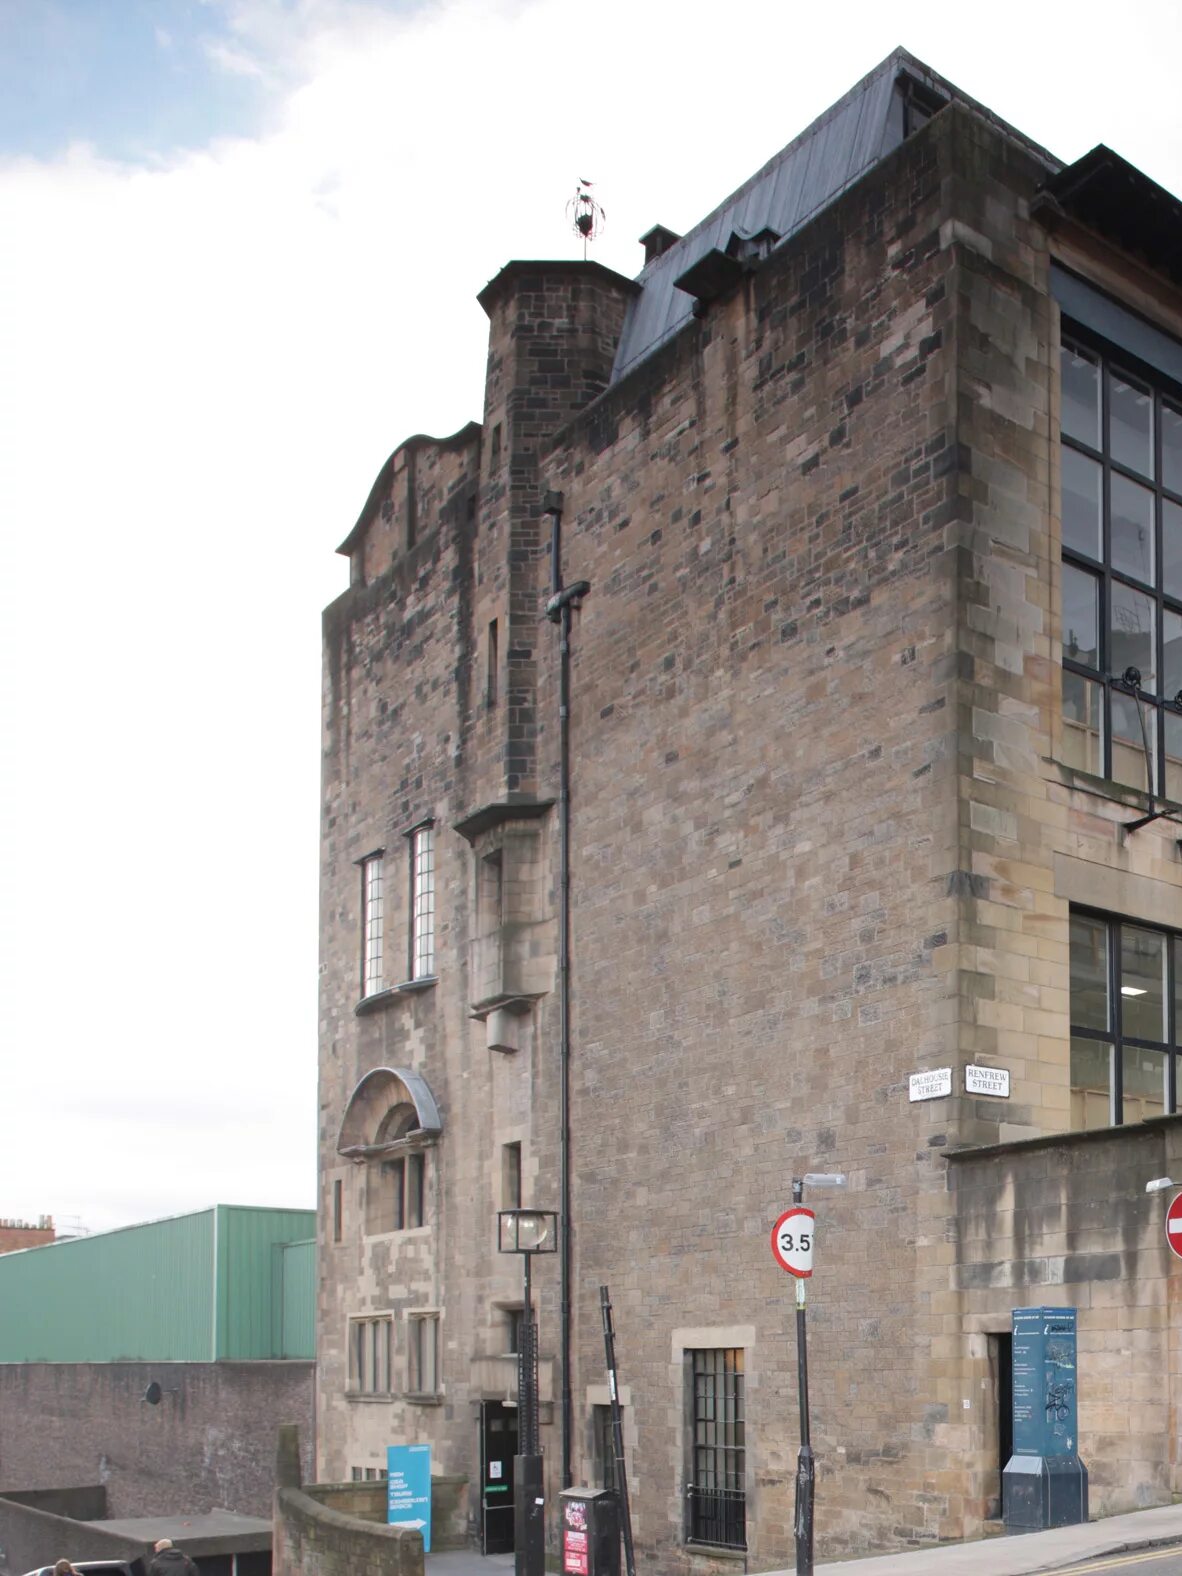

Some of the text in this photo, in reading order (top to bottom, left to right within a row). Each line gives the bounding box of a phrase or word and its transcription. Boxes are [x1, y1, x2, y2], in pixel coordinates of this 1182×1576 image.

[911, 1072, 949, 1086] DALHOUSIE
[968, 1068, 1007, 1081] RENFREW
[917, 1083, 943, 1095] STREET
[972, 1080, 1002, 1091] STREET
[780, 1233, 814, 1252] 3.5
